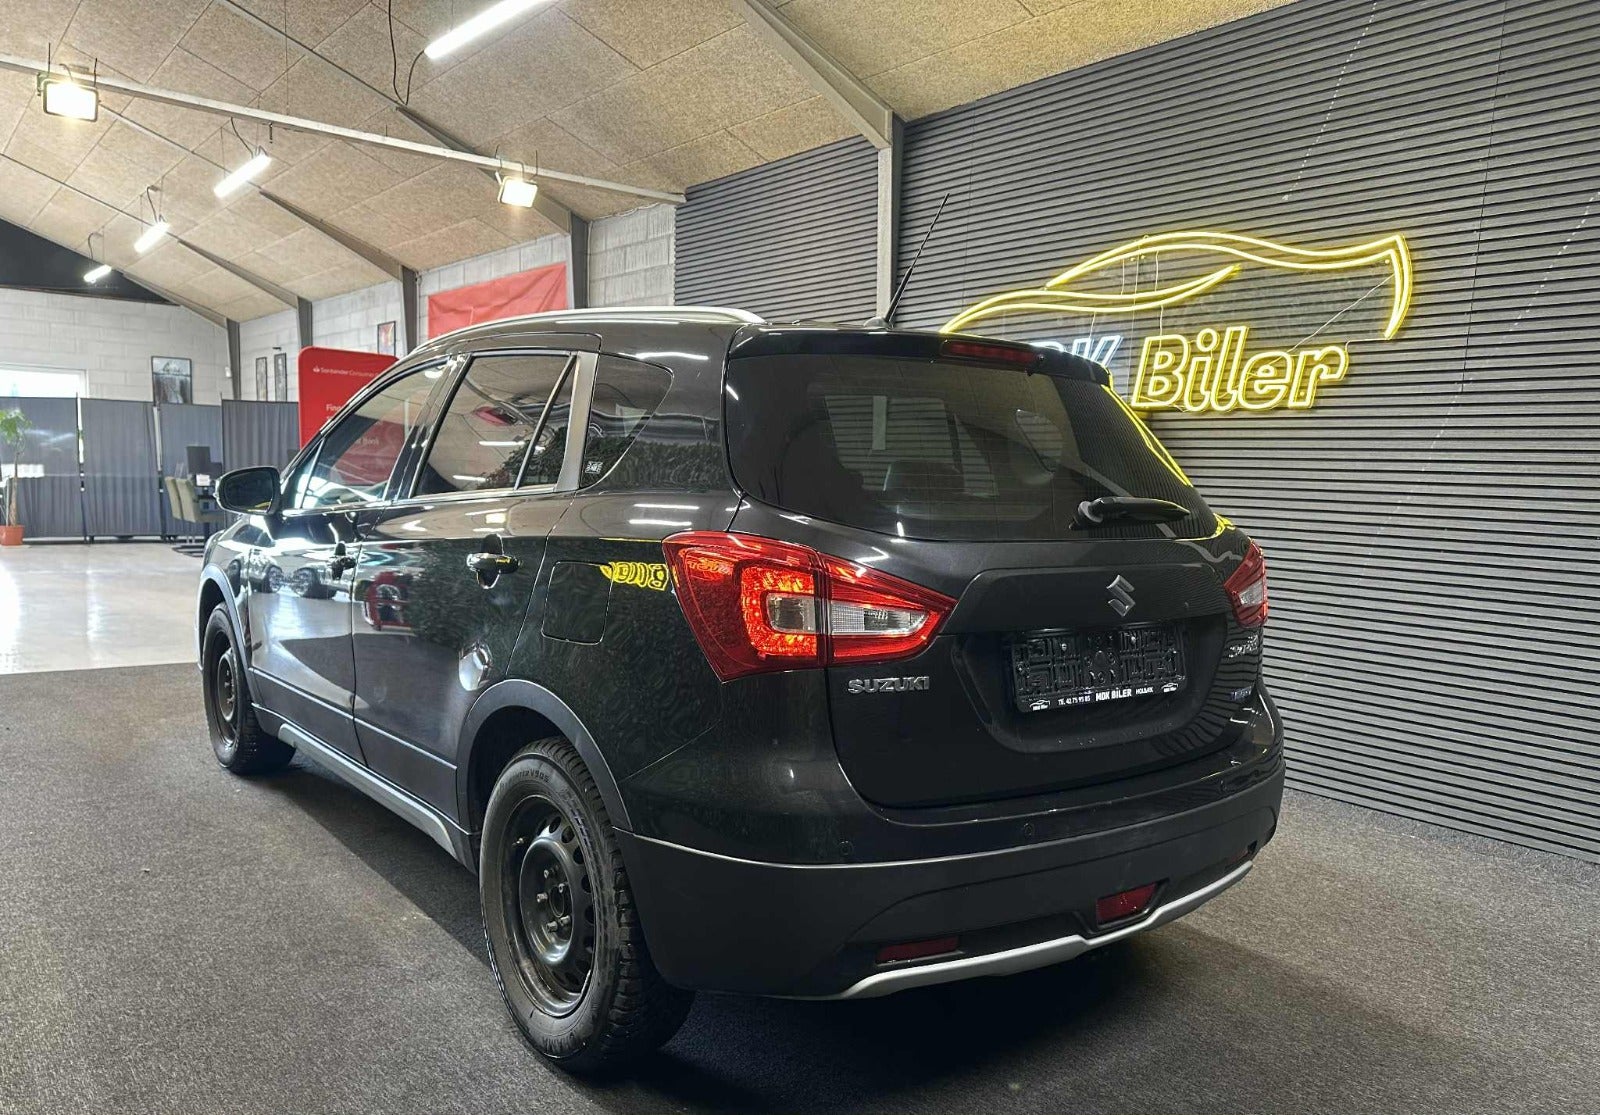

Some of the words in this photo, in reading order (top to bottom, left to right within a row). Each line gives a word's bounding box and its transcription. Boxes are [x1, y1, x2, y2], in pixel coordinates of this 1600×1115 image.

[320, 367, 349, 376] Santander
[1131, 326, 1348, 412] Biler
[848, 676, 930, 694] SUZUKI
[1111, 688, 1132, 700] BILER
